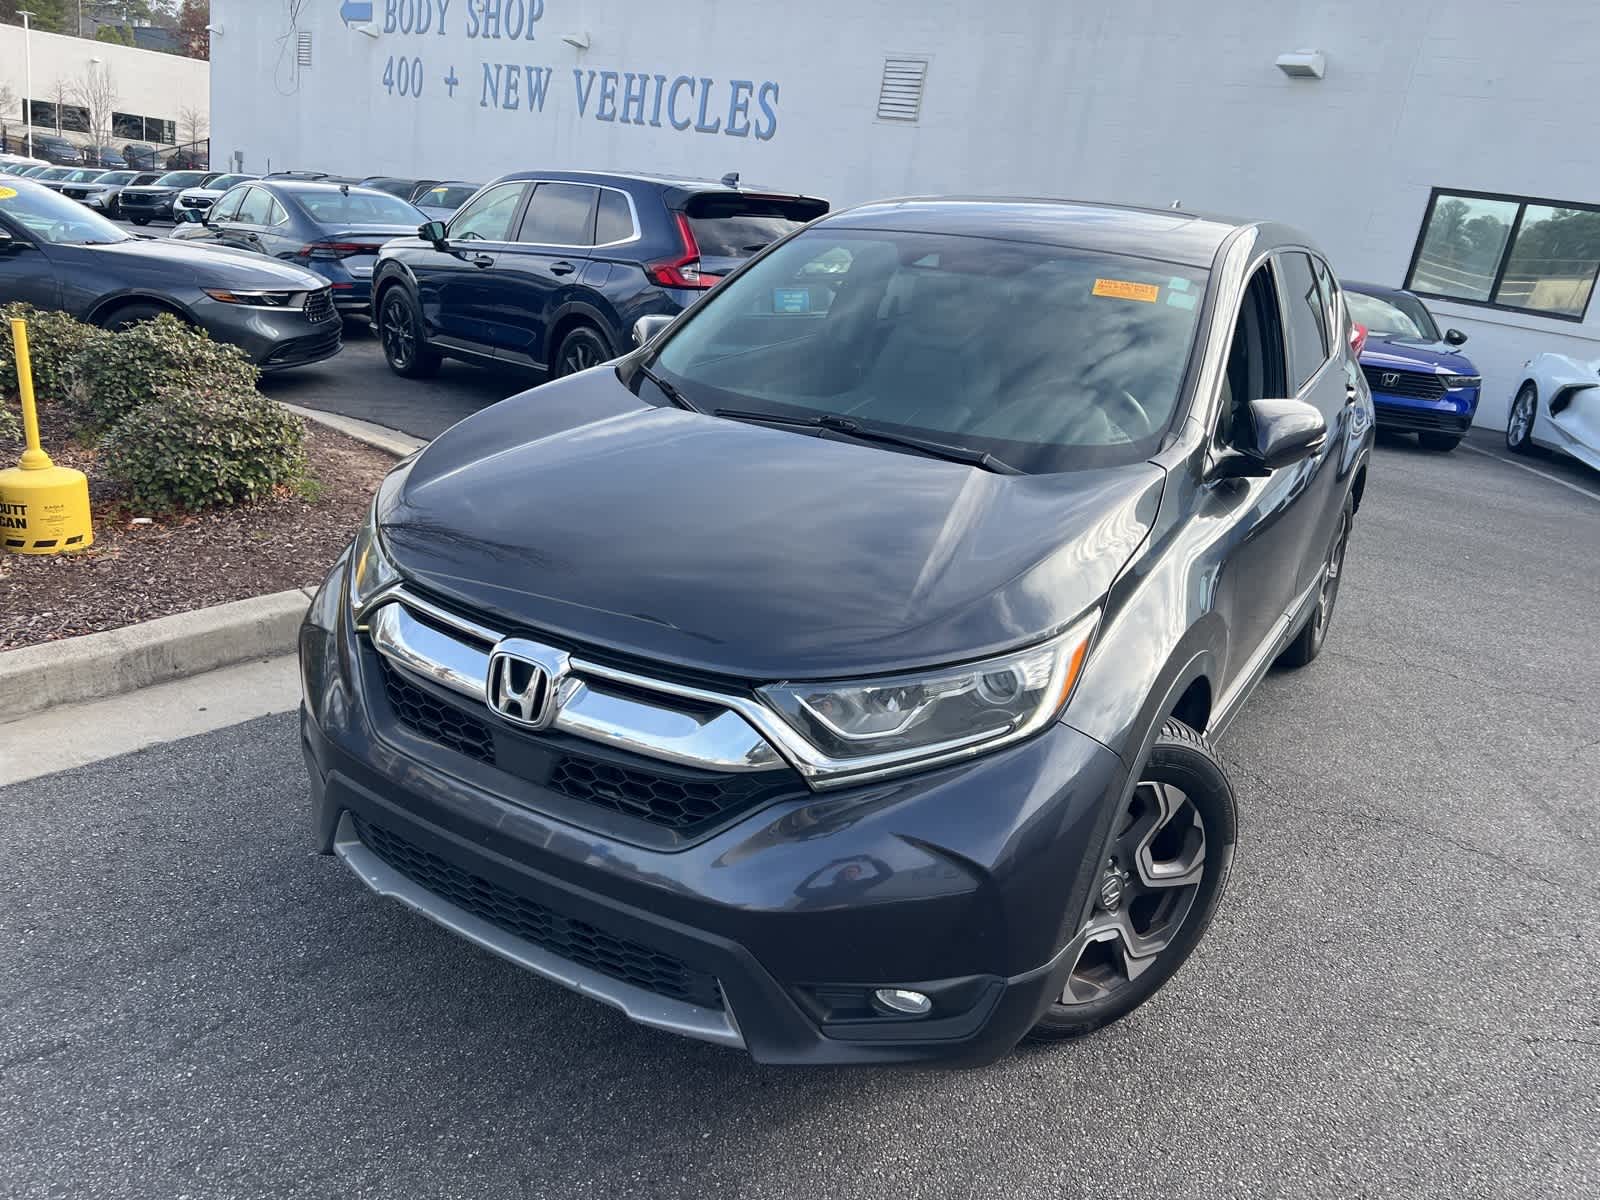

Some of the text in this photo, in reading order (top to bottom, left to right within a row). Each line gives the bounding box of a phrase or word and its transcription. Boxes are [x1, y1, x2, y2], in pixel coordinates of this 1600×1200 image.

[383, 0, 545, 41] BODY SHOP
[382, 55, 780, 142] 400 + NEW VEHICLES
